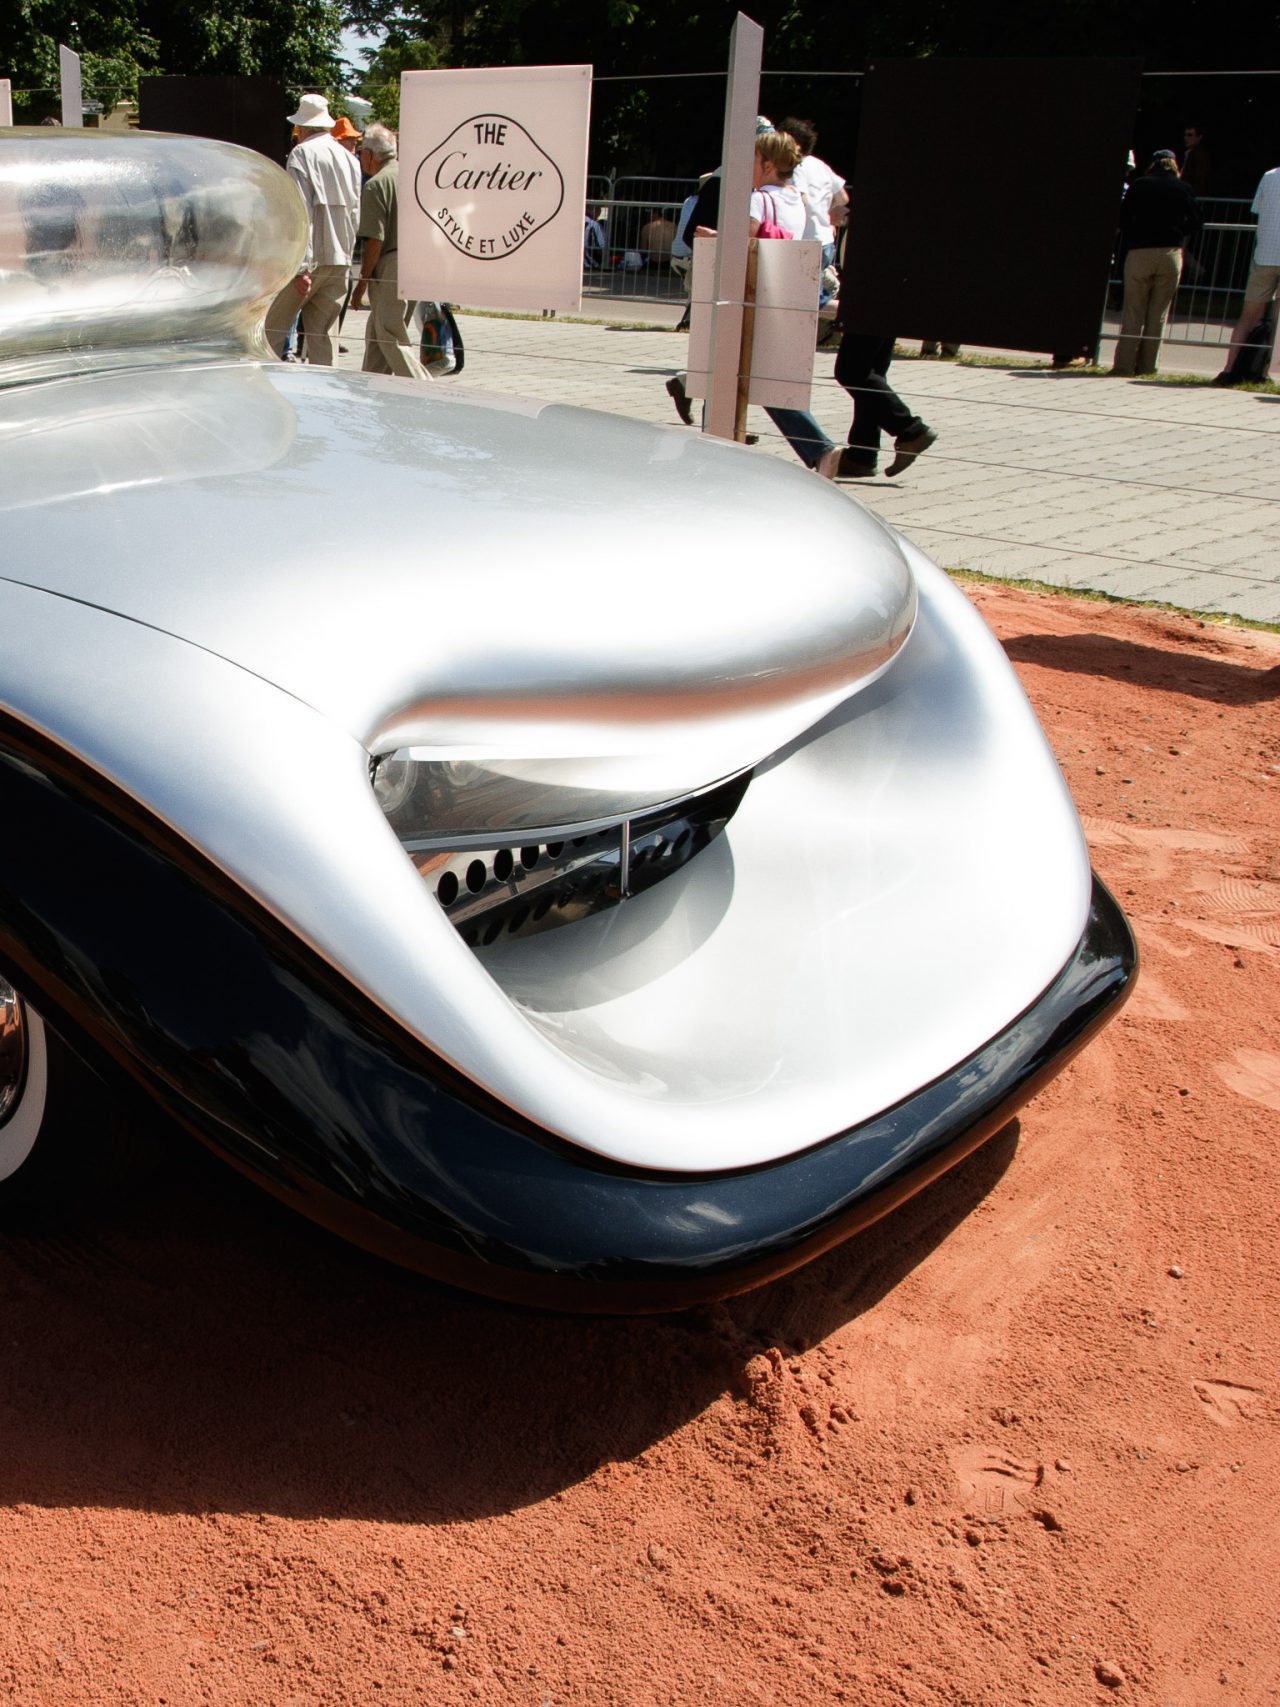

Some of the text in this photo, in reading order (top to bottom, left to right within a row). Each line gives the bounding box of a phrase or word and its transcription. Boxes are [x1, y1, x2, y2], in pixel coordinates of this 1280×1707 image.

[474, 123, 507, 145] THE
[435, 151, 543, 191] Cartier
[437, 207, 536, 253] STYLE ET LUXE
